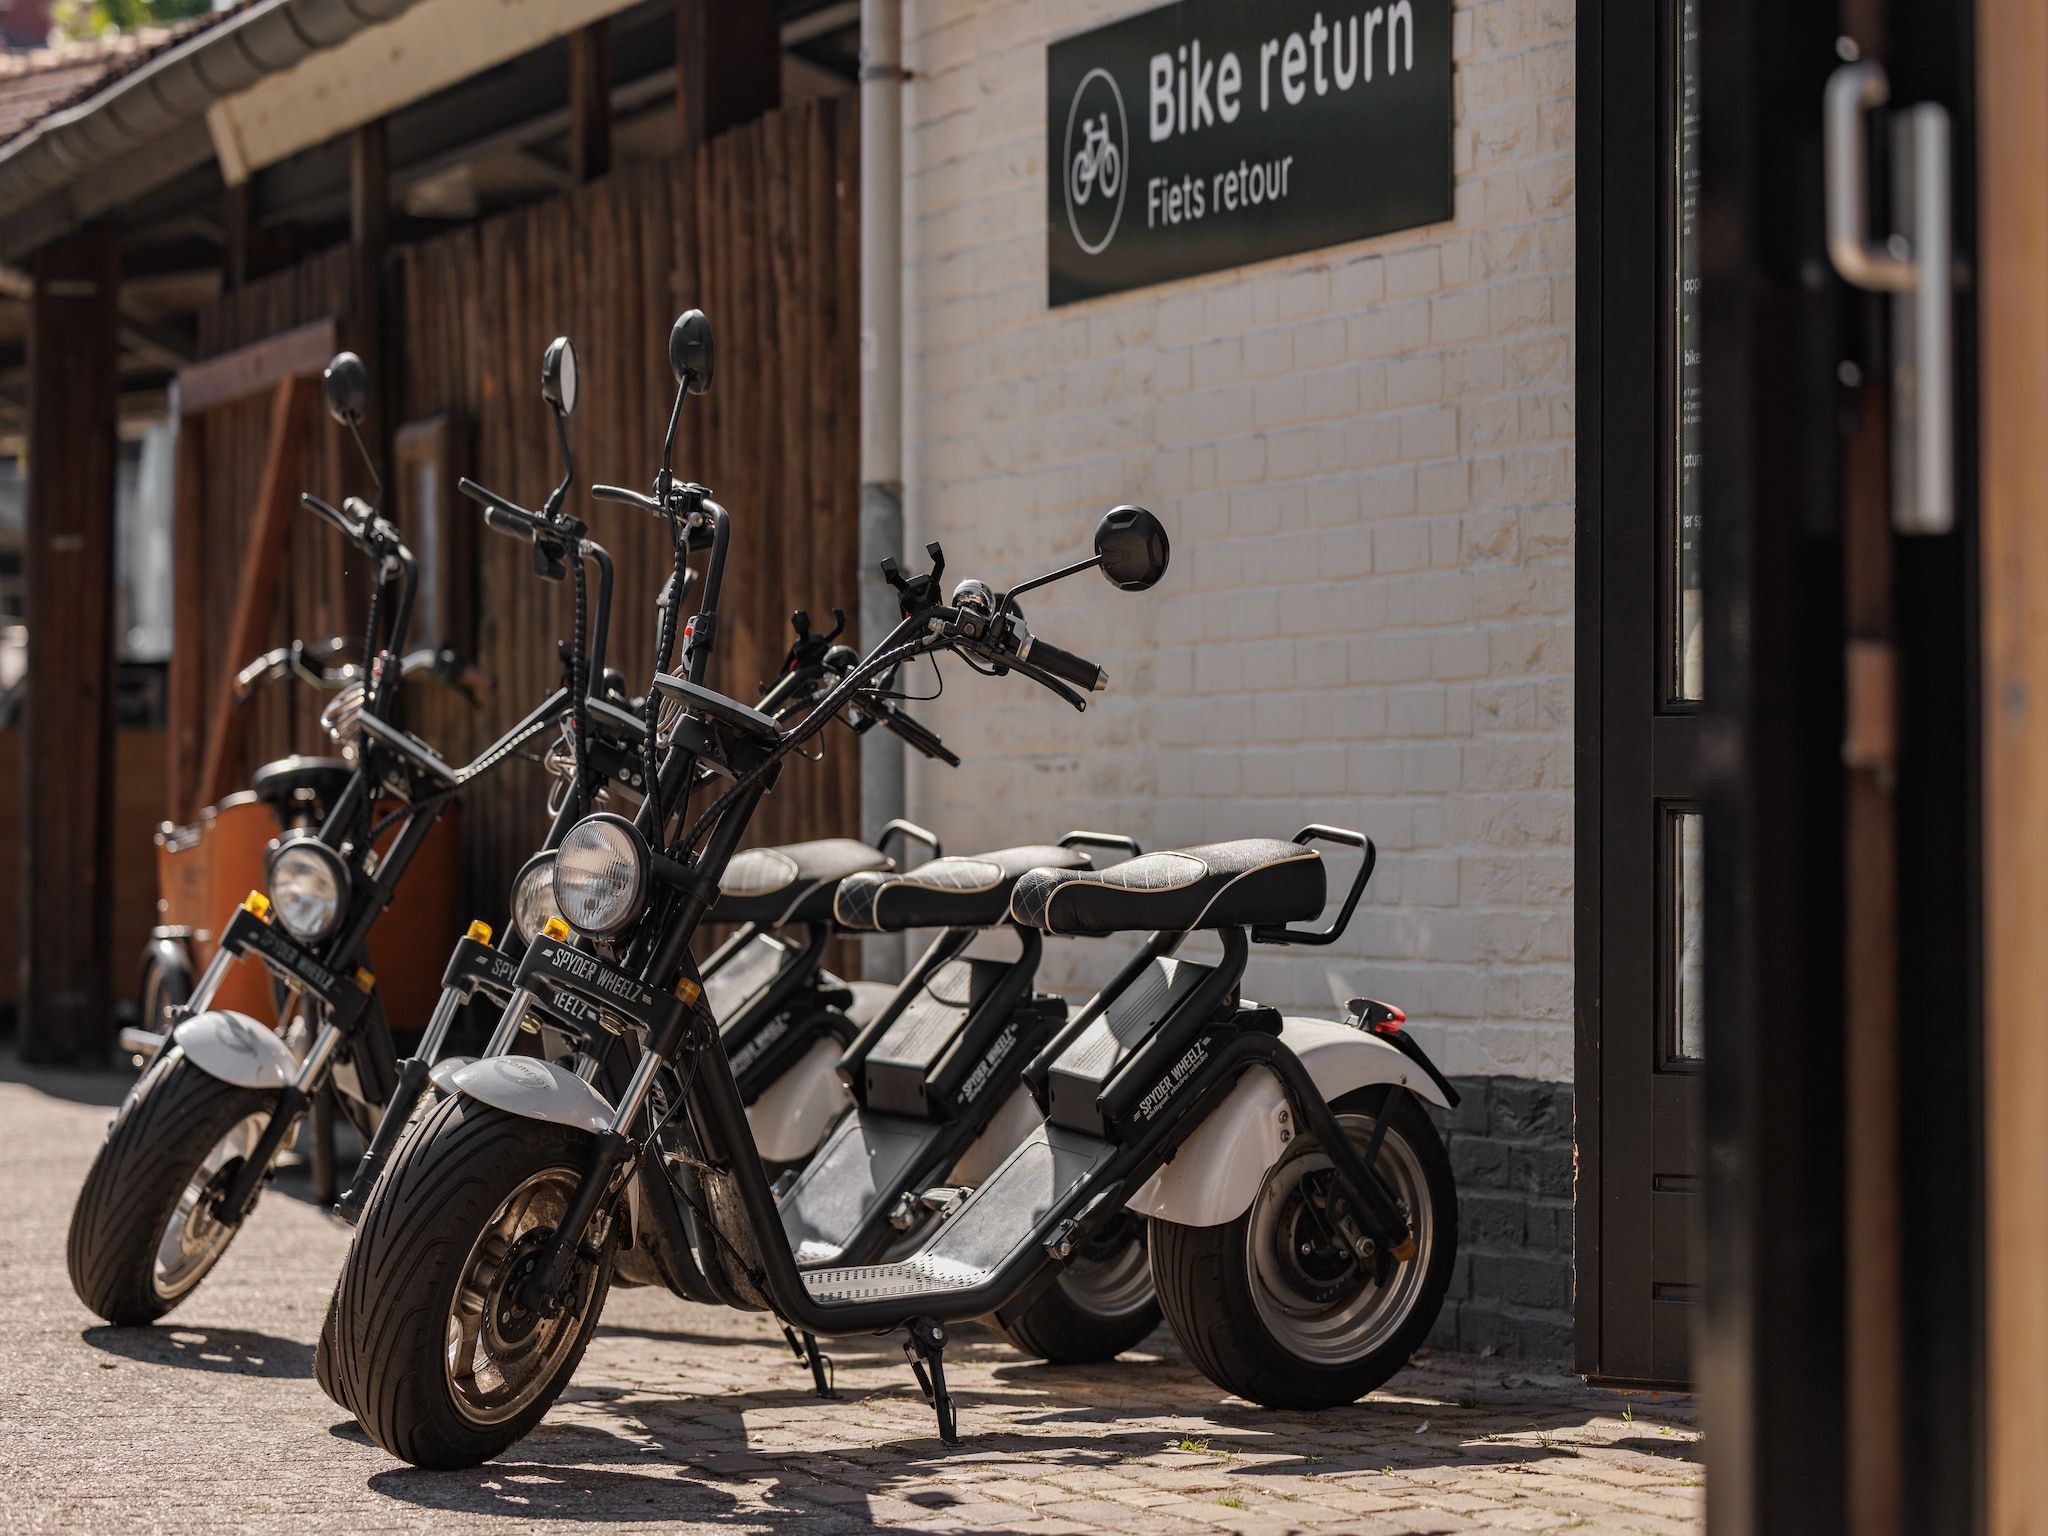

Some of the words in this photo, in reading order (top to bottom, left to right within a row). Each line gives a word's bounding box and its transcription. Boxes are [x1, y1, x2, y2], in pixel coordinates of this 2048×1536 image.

[1149, 38, 1242, 143] Bike
[1259, 0, 1414, 113] return
[1147, 174, 1205, 229] Fiets
[1213, 155, 1293, 214] retour
[490, 957, 518, 982] SPY
[552, 990, 588, 1021] EELZ
[551, 948, 598, 981] SPYDER
[596, 967, 644, 1003] WHEELZ
[1139, 1075, 1173, 1115] SPYDER
[1170, 1041, 1205, 1080] WHEELZ
